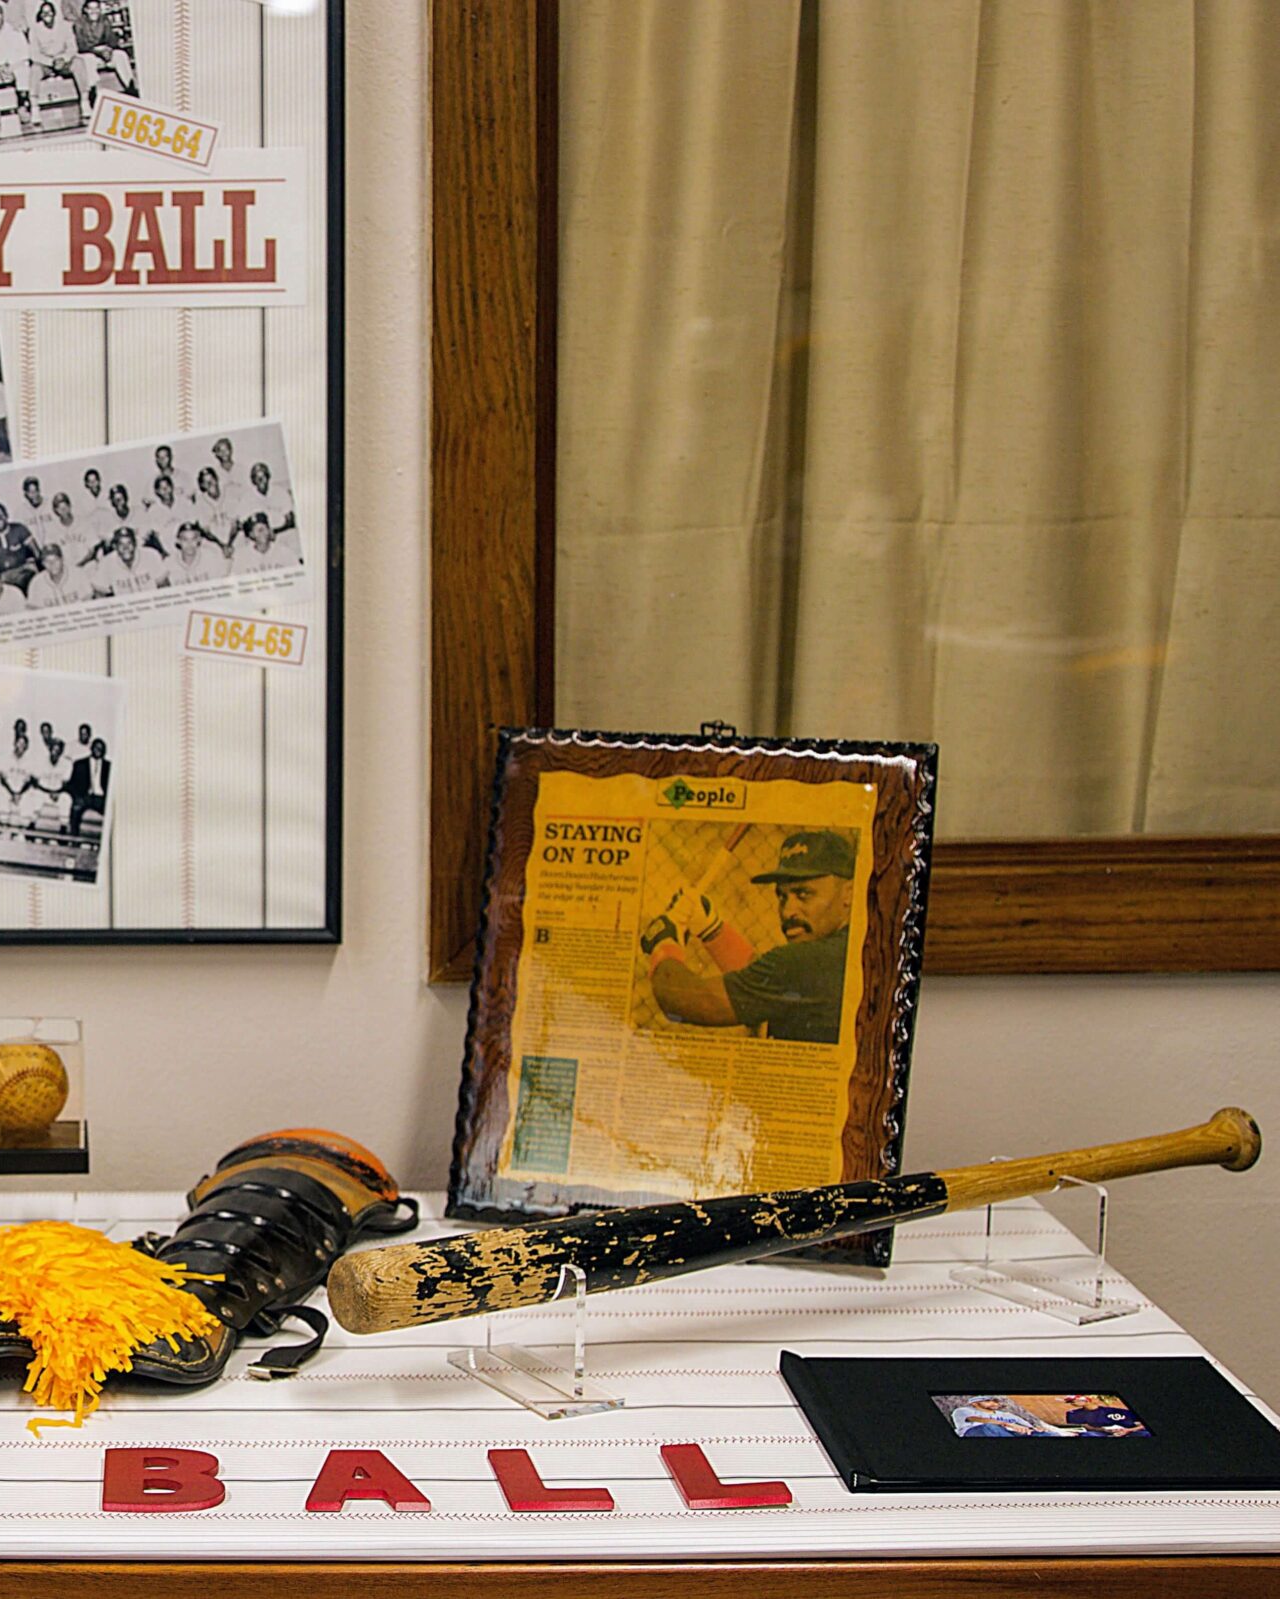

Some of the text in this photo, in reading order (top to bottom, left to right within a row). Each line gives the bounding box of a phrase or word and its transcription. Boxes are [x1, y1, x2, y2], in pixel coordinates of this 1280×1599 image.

[108, 105, 201, 160] 1963-64
[62, 190, 276, 286] BALL
[199, 616, 294, 659] 1964-65
[673, 785, 736, 807] People
[544, 822, 642, 843] STAYING
[542, 846, 630, 866] ON TOP
